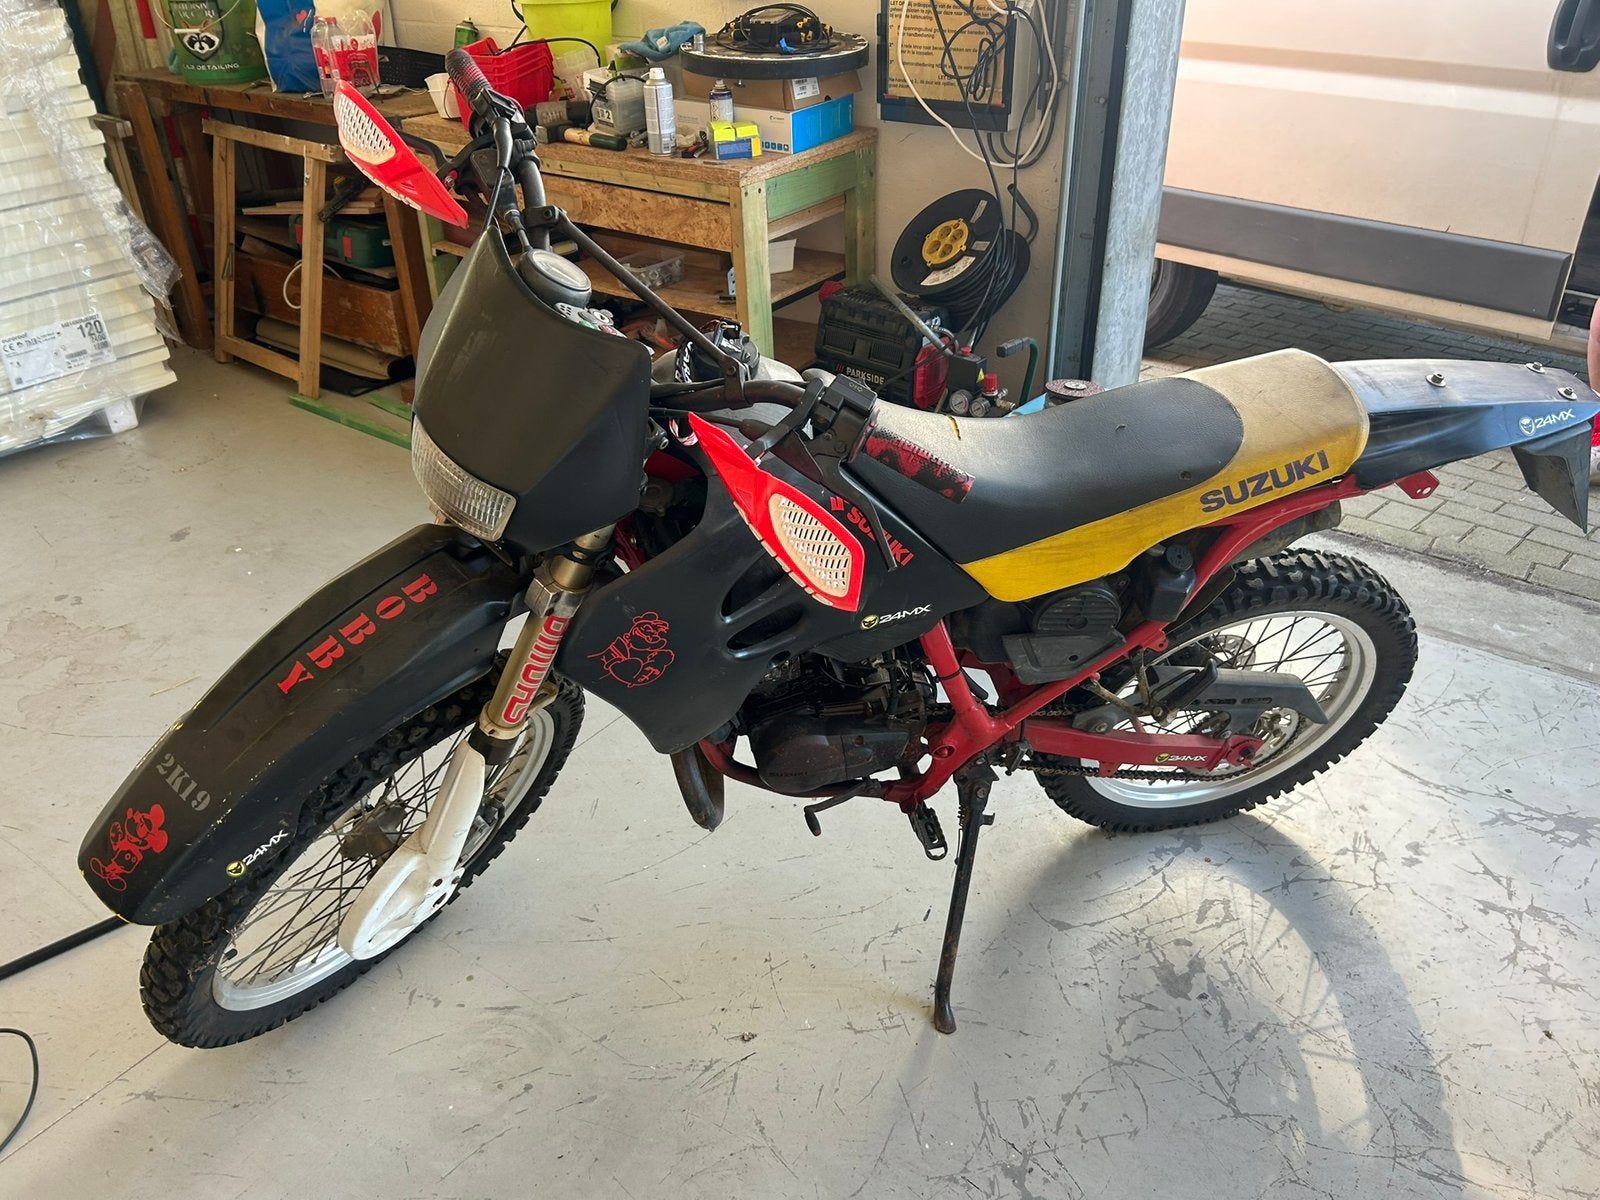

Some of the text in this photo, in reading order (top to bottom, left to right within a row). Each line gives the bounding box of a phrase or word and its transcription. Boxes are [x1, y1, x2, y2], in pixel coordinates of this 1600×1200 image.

[196, 63, 240, 71] DETAILING
[77, 319, 104, 338] 120
[846, 366, 886, 385] PARKSIDE
[1534, 408, 1576, 428] 24MX
[1199, 450, 1330, 513] SUZUKI
[846, 506, 914, 566] SUKI
[879, 604, 932, 624] 24MX
[276, 573, 438, 695] BOBBY
[156, 753, 211, 811] 2K19
[242, 829, 289, 865] 24MX
